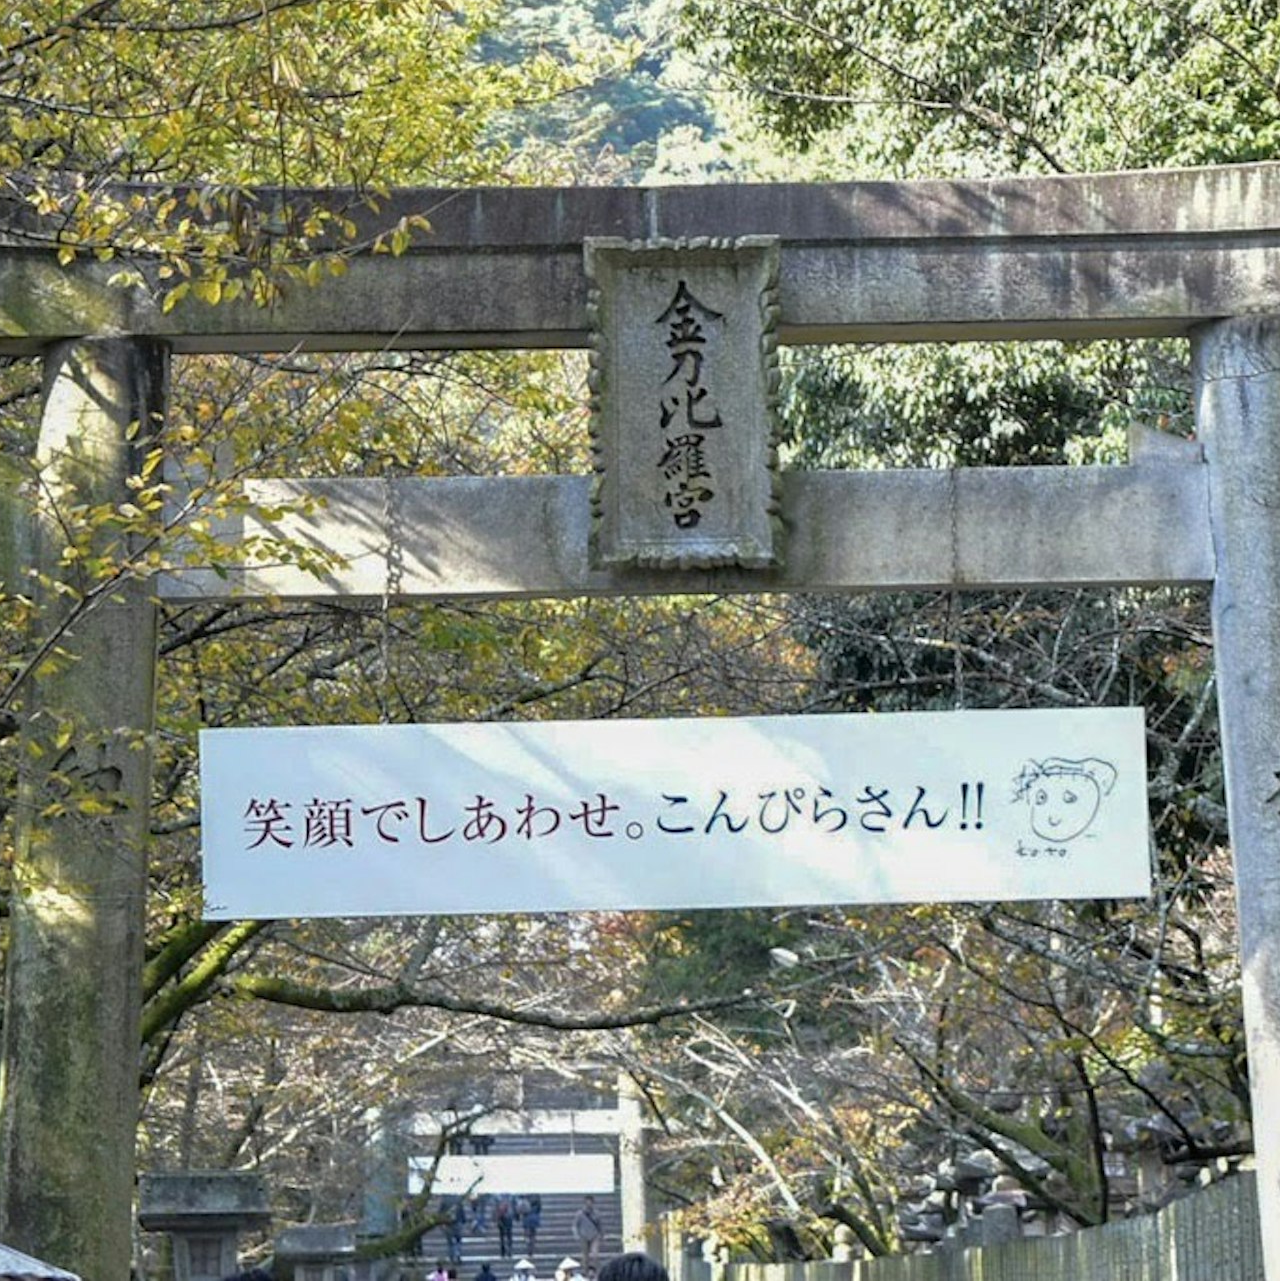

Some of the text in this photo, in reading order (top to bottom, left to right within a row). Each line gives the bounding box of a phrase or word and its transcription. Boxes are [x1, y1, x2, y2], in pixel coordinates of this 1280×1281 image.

[655, 279, 724, 530] 金刀比羅宮
